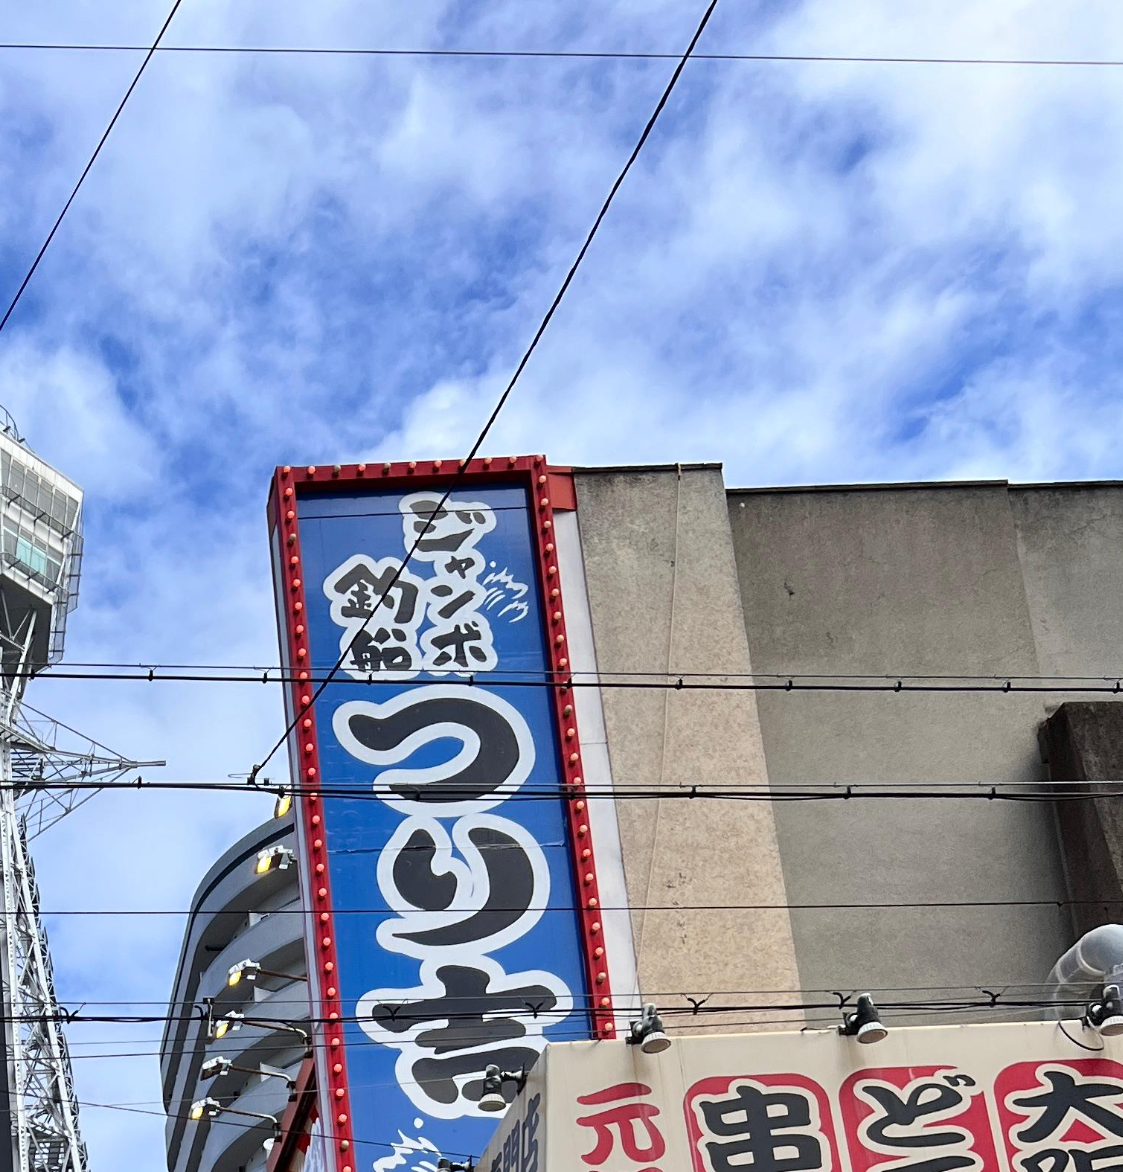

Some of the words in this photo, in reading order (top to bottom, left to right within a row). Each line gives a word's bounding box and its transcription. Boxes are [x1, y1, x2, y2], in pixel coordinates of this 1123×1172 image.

[331, 560, 418, 677] 釣船
[405, 496, 491, 673] ジャンボ
[348, 692, 558, 1106] つり吉
